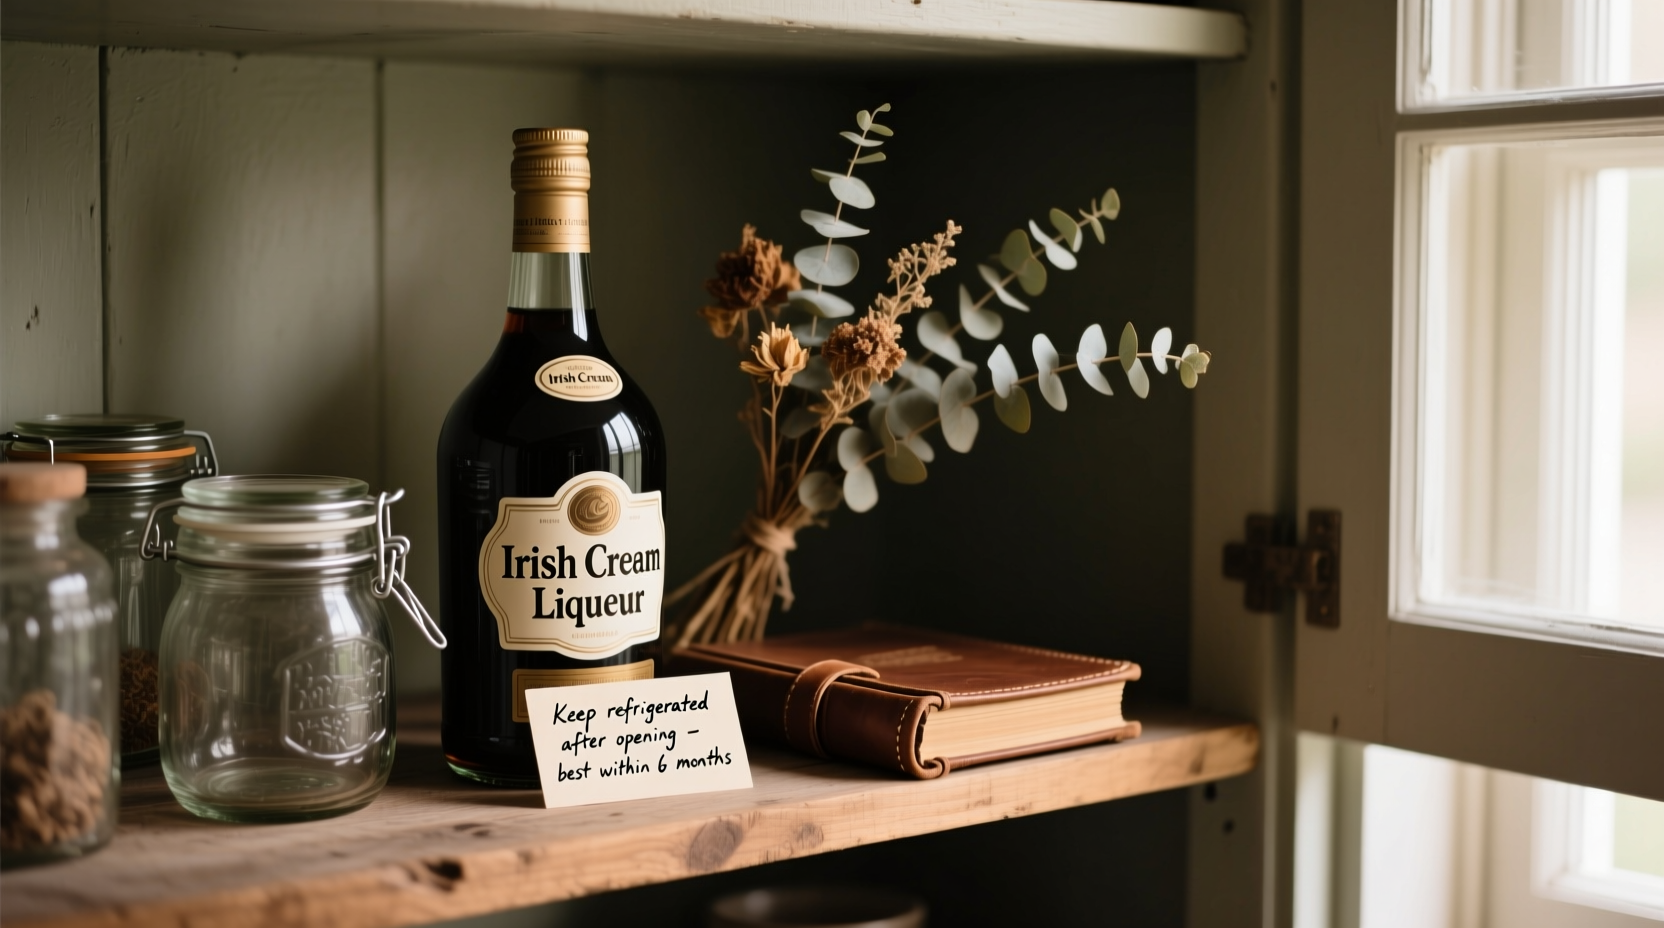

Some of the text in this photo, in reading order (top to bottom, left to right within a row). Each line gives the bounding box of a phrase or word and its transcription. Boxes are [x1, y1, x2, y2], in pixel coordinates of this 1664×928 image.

[548, 372, 576, 385] Irish
[501, 543, 661, 580] Irish Cream
[531, 586, 645, 628] Liqueur
[552, 689, 709, 733] Keep refrigerated
[561, 731, 607, 757] after
[615, 727, 677, 755] opening
[557, 746, 732, 783] best within 6 months
